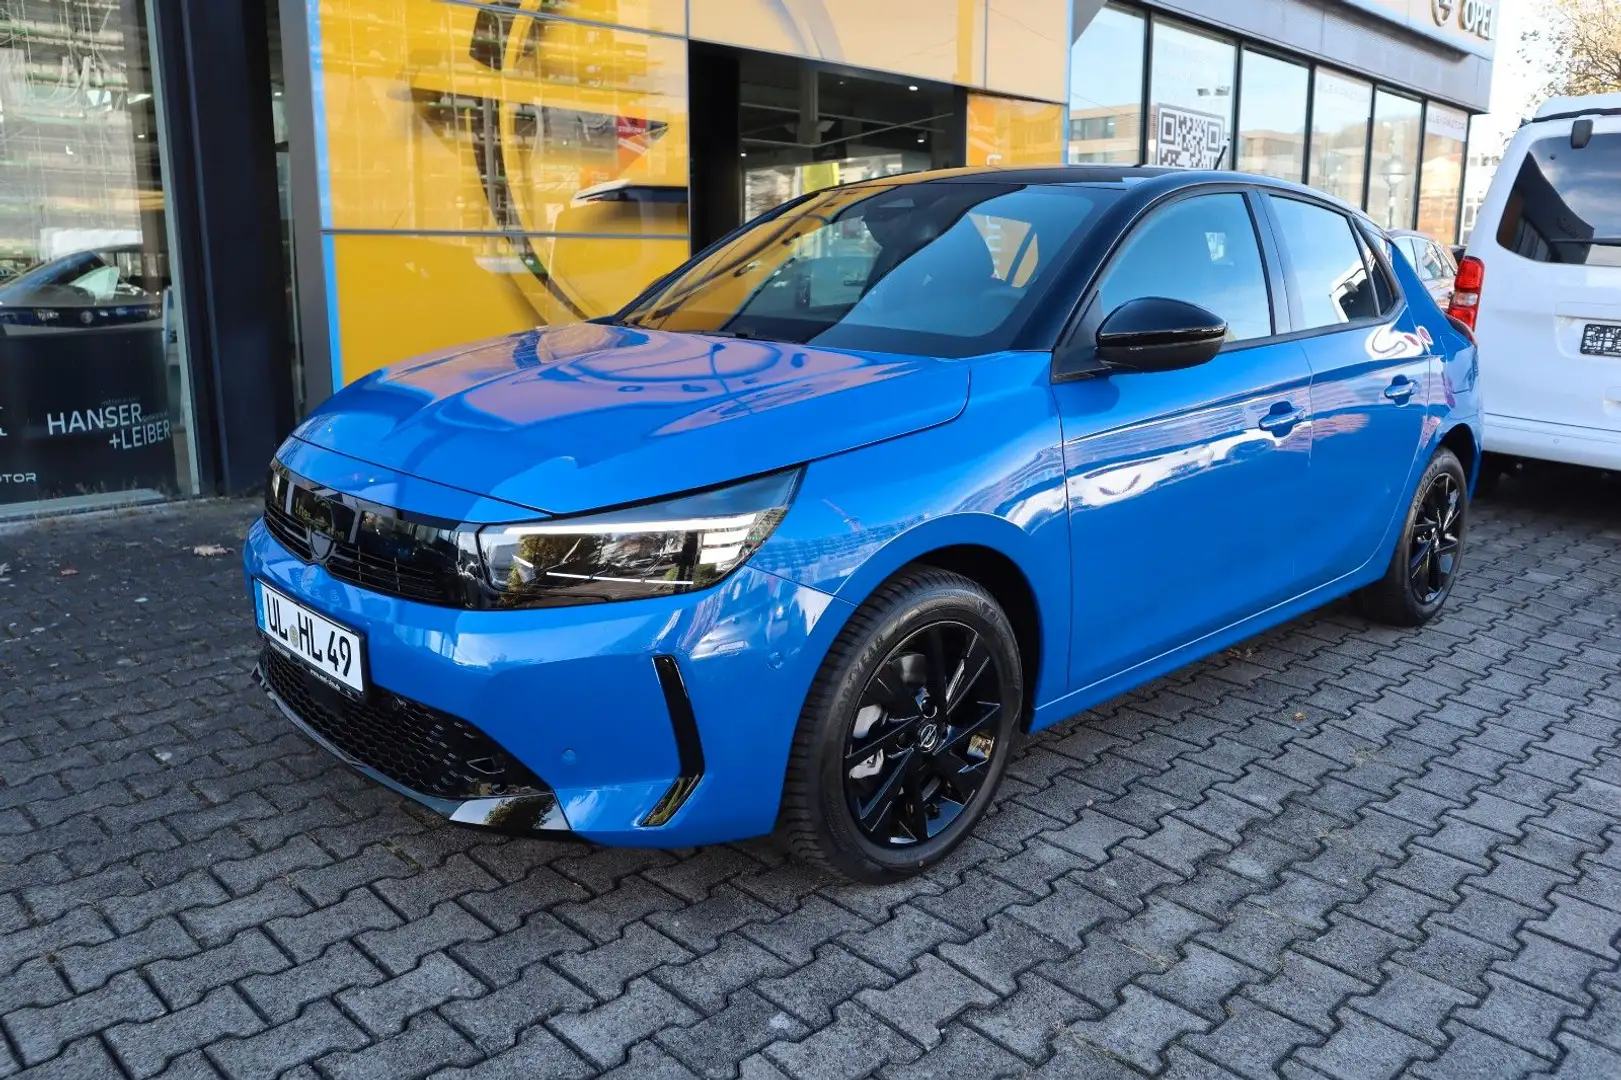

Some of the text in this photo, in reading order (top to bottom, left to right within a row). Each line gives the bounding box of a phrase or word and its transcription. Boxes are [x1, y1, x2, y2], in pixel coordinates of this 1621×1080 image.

[1461, 0, 1494, 40] OPEL
[47, 403, 142, 436] HANSER
[109, 420, 171, 450] +LEIBER
[267, 593, 288, 641] UL
[297, 611, 323, 662] HL
[327, 630, 352, 677] 49
